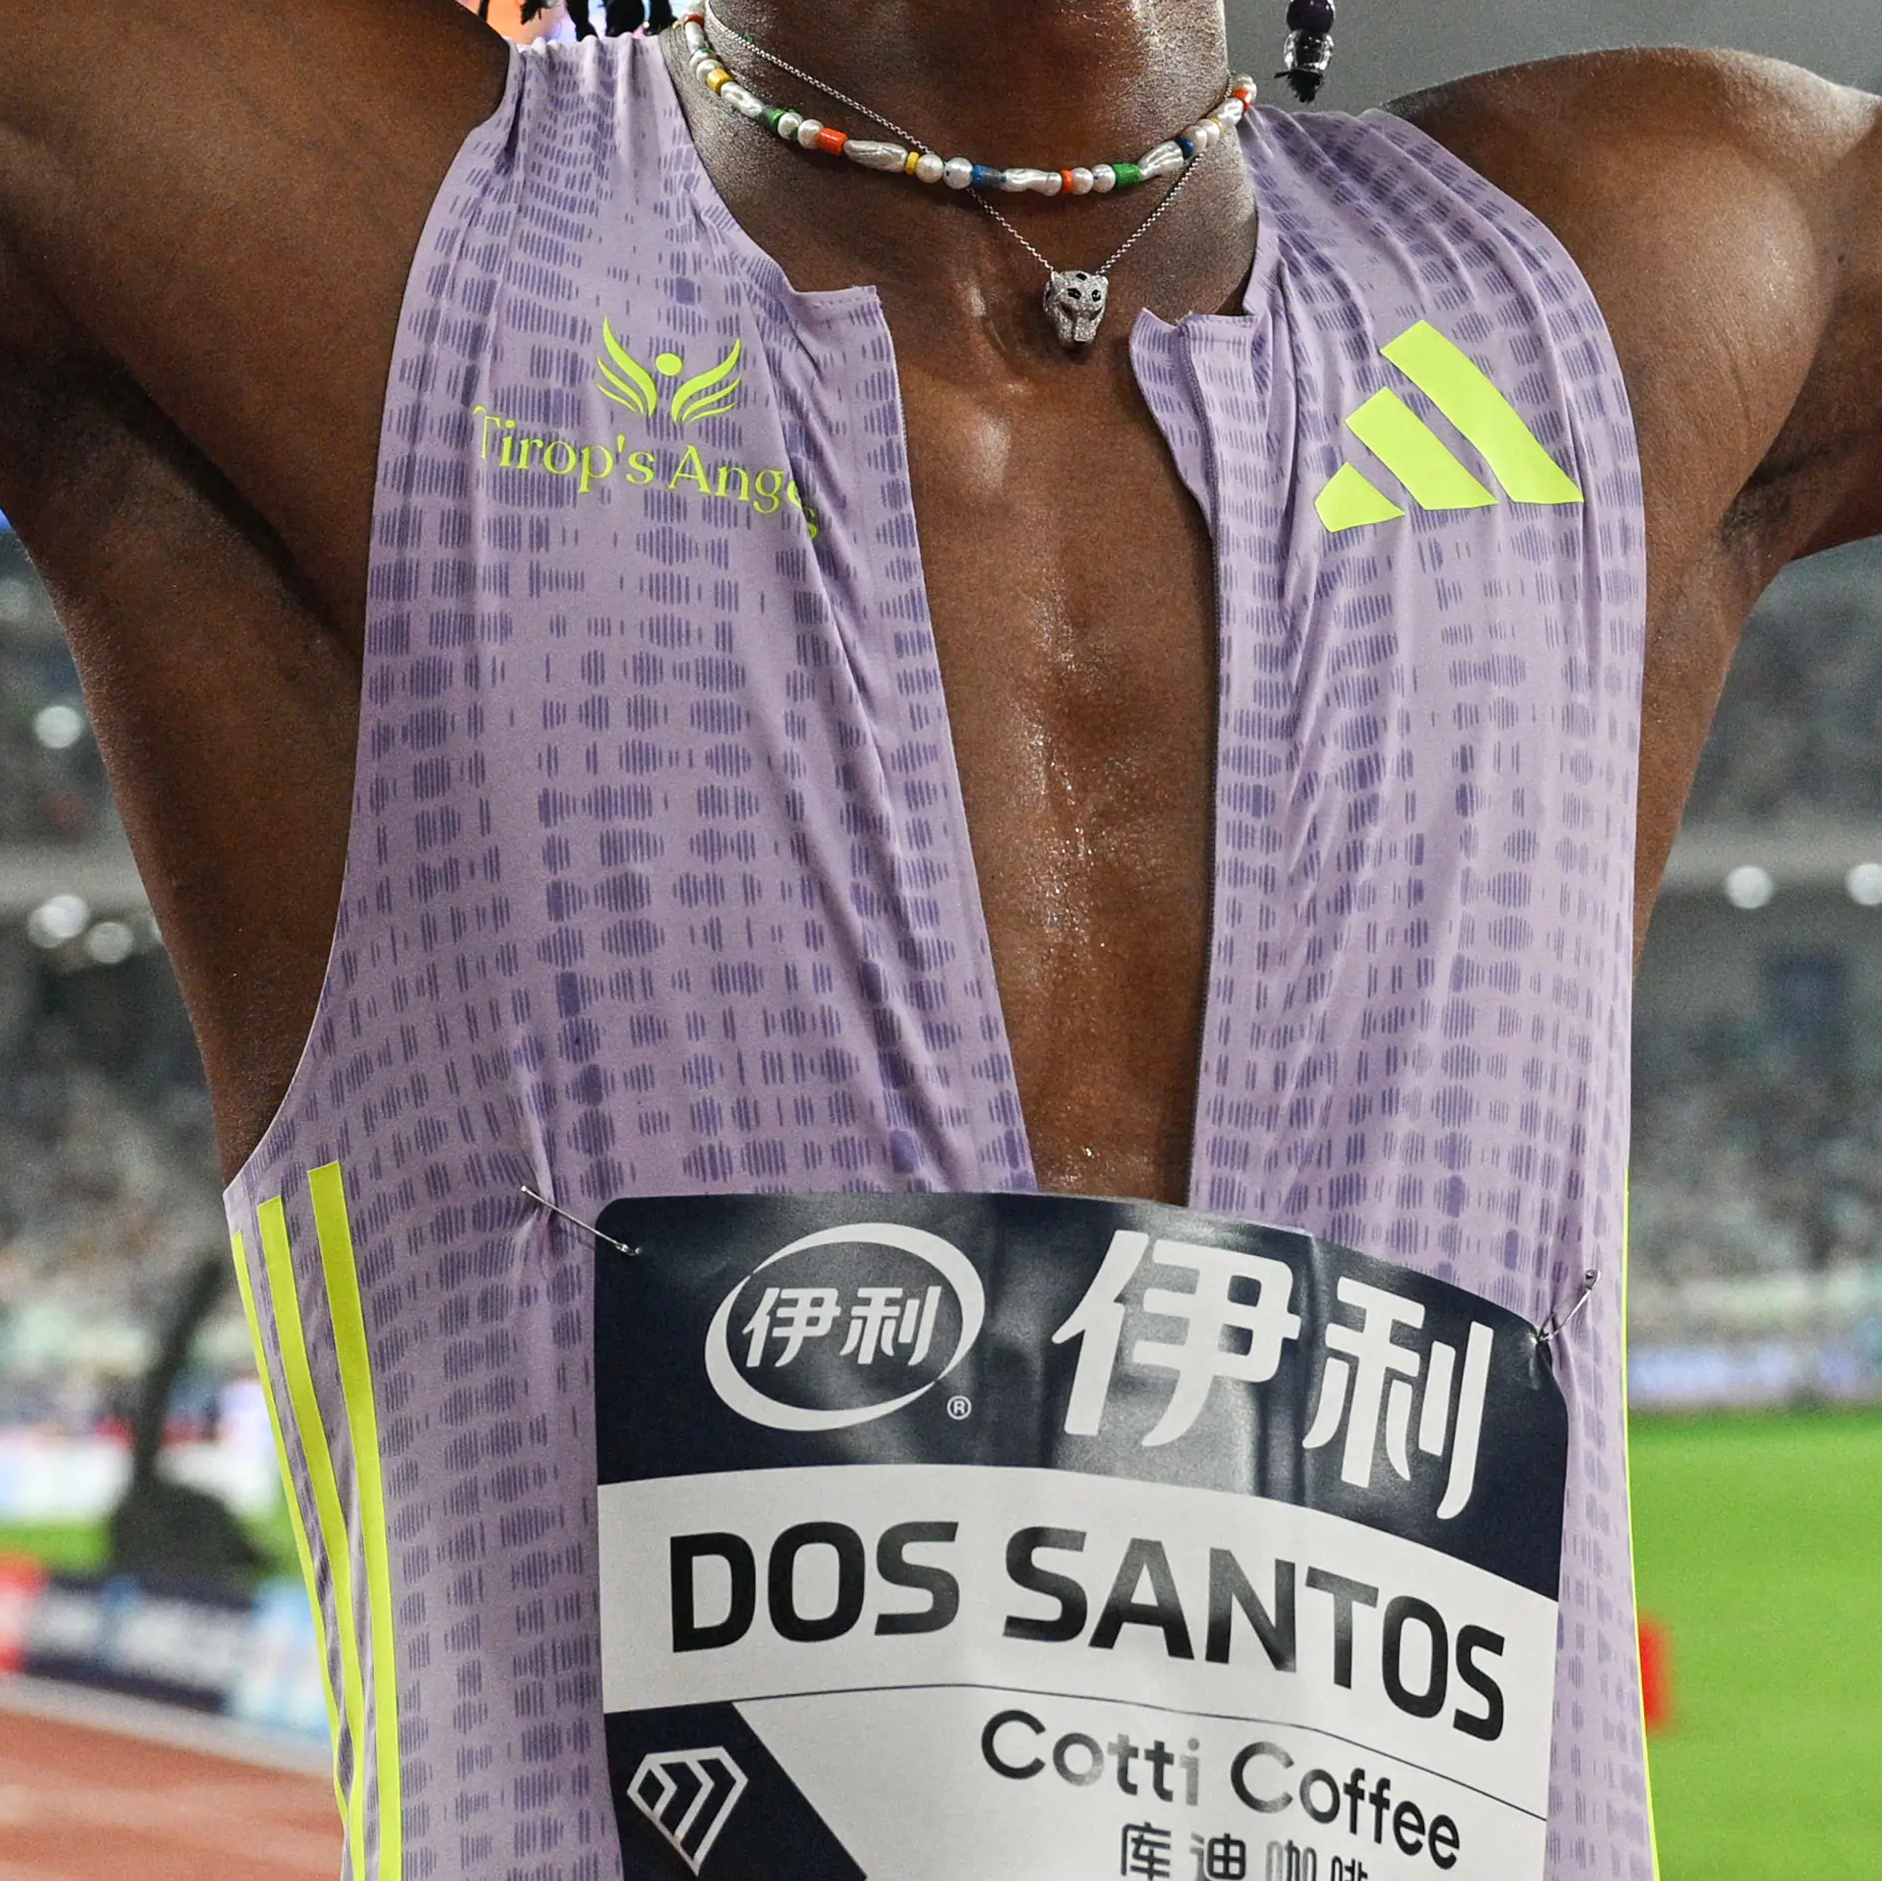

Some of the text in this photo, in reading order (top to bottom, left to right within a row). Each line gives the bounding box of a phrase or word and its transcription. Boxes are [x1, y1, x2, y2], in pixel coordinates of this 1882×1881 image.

[472, 405, 818, 540] Tirop's Ang
[741, 1285, 943, 1368] 伊利
[1051, 1229, 1495, 1520] 伊利
[669, 1521, 1506, 1741] DOS SANTOS
[981, 1708, 1461, 1870] Cotti Coffee
